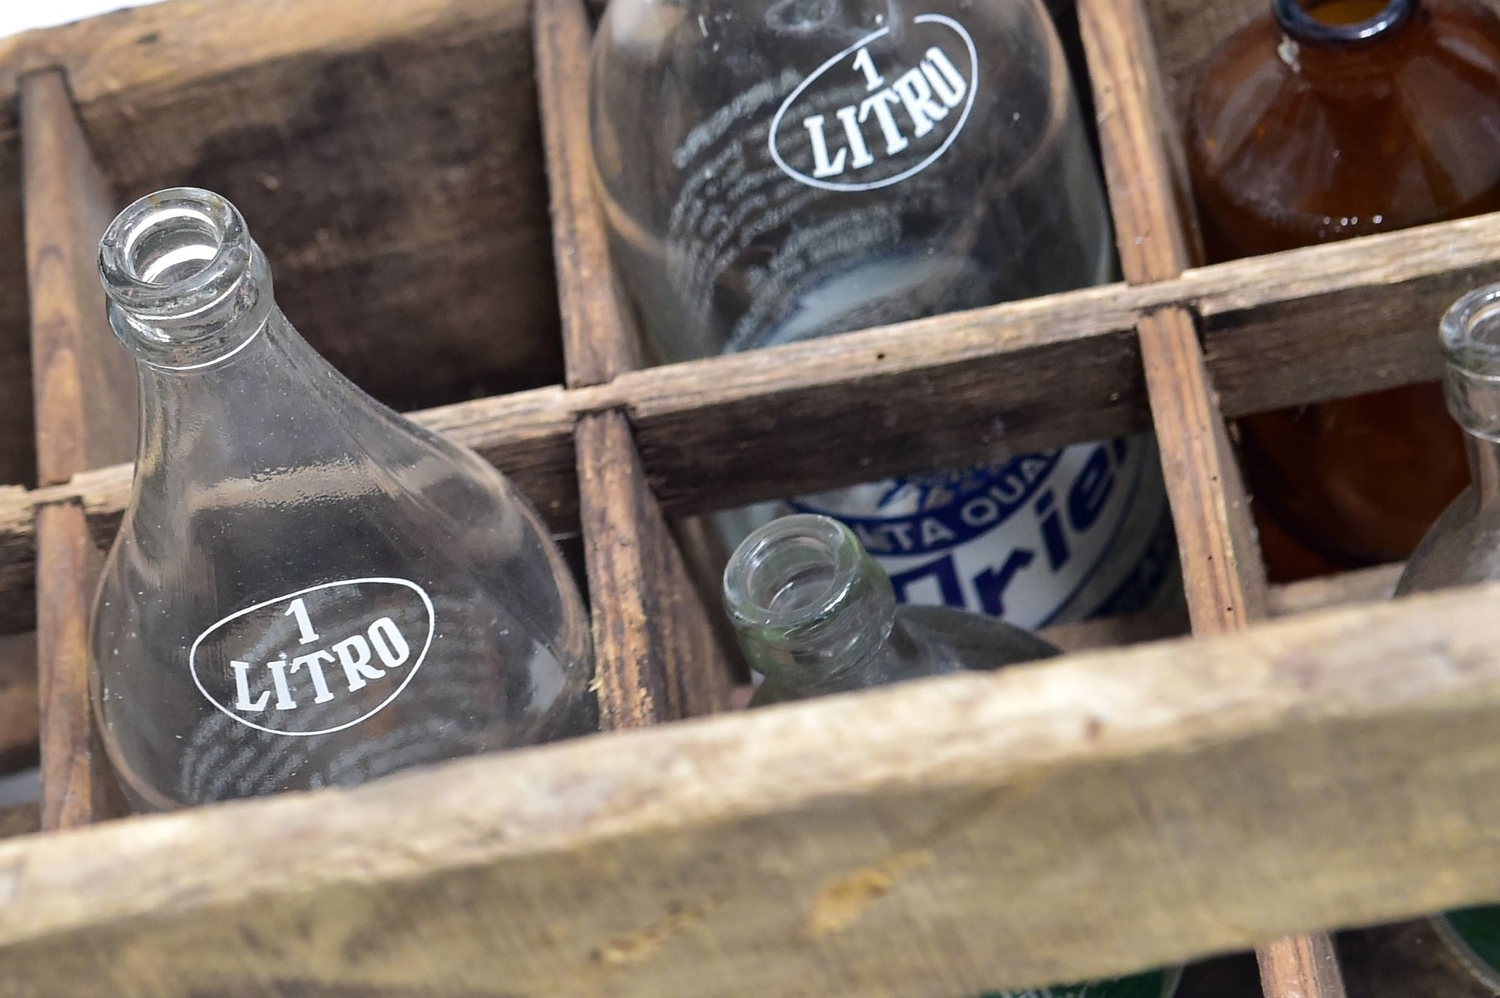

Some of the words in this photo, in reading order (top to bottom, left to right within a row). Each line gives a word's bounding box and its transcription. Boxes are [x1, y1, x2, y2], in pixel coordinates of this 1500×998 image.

[852, 47, 885, 91] 1
[803, 46, 968, 179] LITRO
[961, 455, 1052, 528] QUA
[285, 598, 319, 644] 1
[231, 616, 411, 712] LITRO
